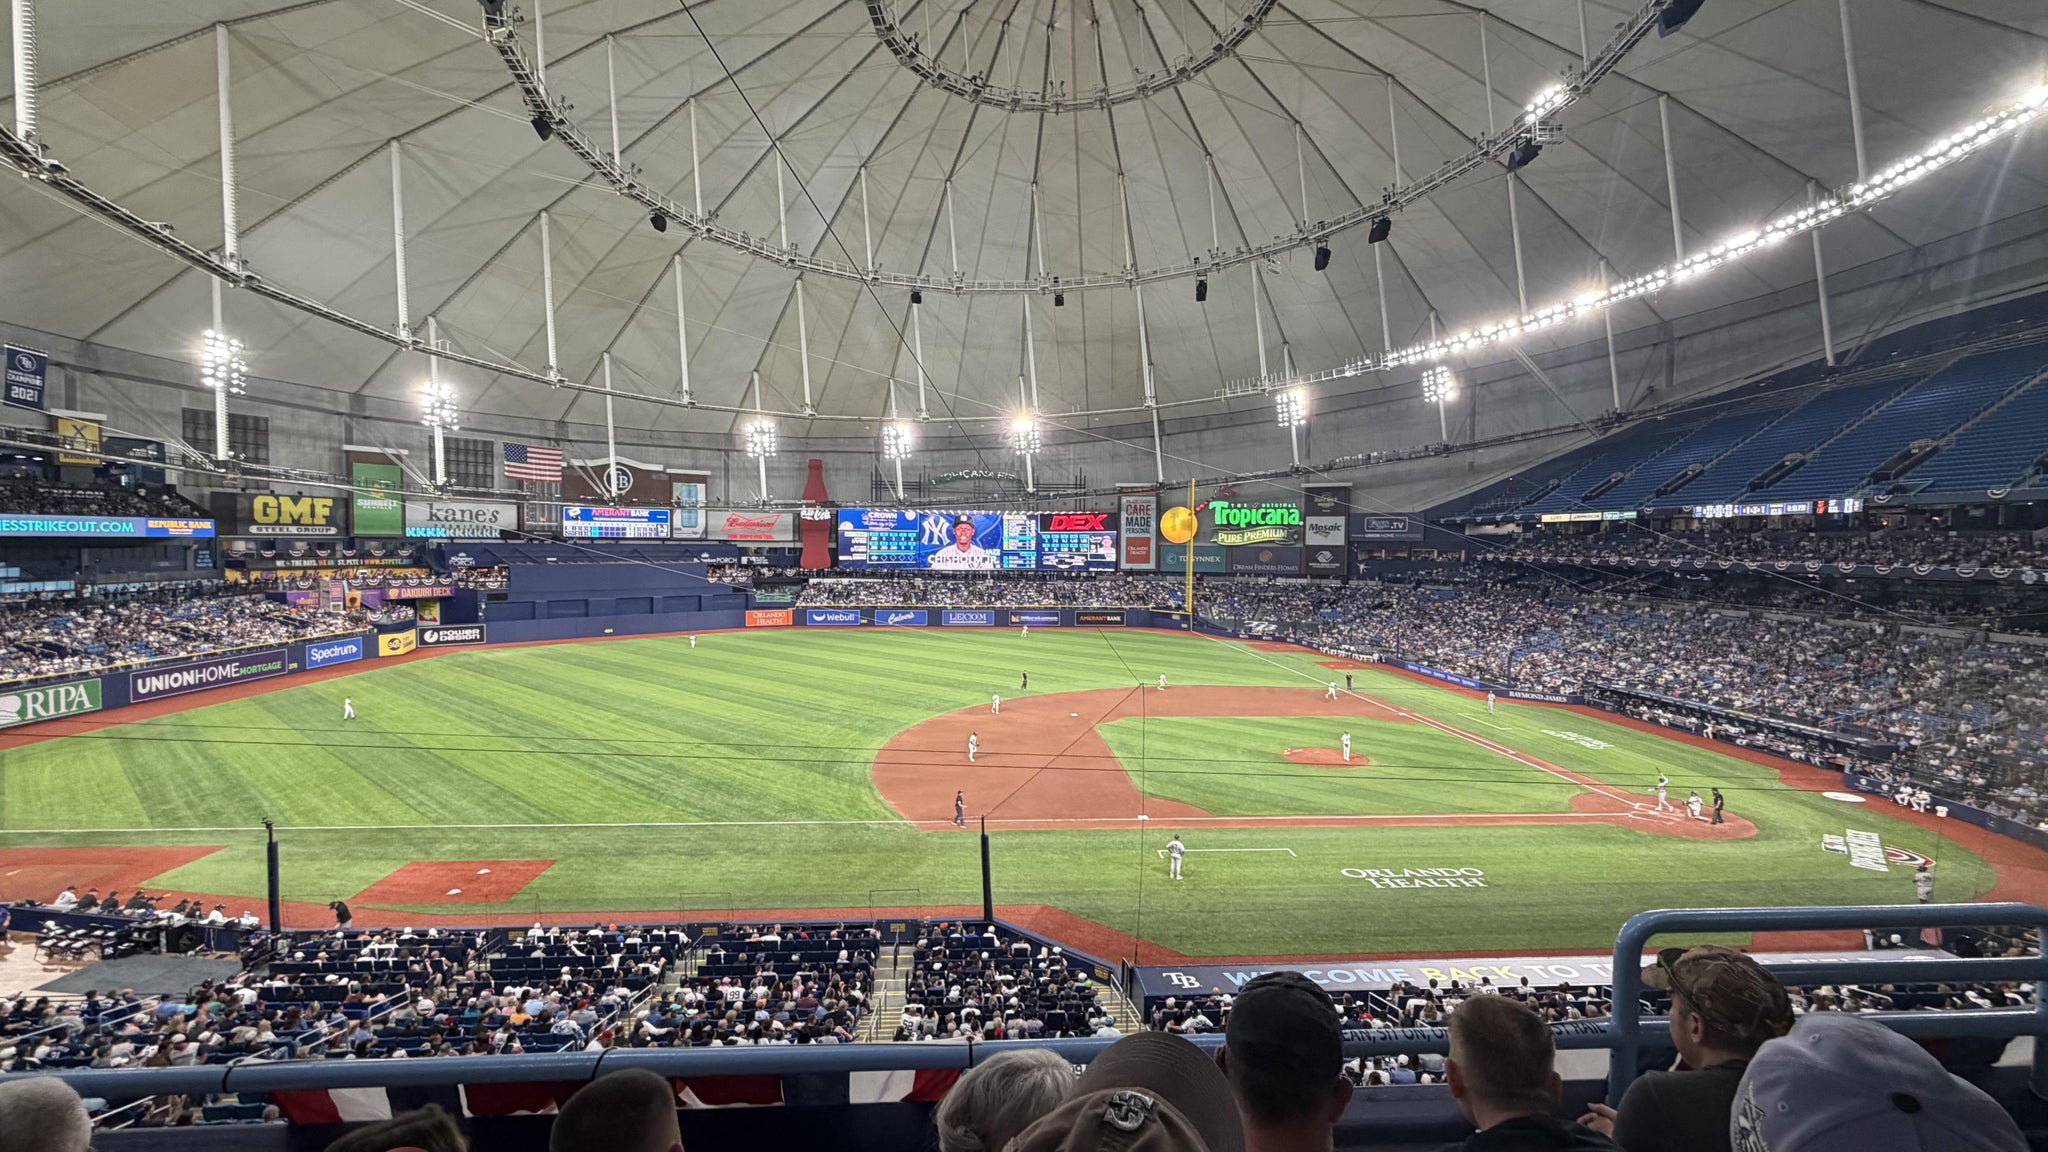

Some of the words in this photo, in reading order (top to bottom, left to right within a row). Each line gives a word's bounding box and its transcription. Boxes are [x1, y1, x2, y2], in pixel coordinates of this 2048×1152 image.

[10, 386, 38, 402] 2021
[253, 495, 334, 525] GMF
[427, 502, 500, 524] kane's
[592, 509, 630, 517] AMERANT
[630, 510, 650, 518] BANK
[867, 511, 898, 519] CROWN
[1125, 504, 1151, 516] CARE
[1208, 500, 1300, 528] Tropicana
[147, 520, 188, 530] REPUBLIC
[188, 521, 212, 530] BANK
[1049, 514, 1108, 531] DEX
[1125, 516, 1151, 528] MADE
[1308, 522, 1342, 533] Mosaic
[1217, 531, 1243, 543] PURE
[1243, 528, 1288, 541] PREMIUM
[716, 556, 738, 564] PORCH
[1233, 563, 1253, 572] DREAM
[1278, 563, 1299, 571] HOMES
[401, 588, 432, 599] DAIQUIRI
[433, 587, 451, 597] DECK
[826, 612, 855, 622] Webull
[949, 612, 987, 621] LECOM
[310, 643, 355, 663] Spectrum
[24, 684, 93, 720] RIPA
[1509, 690, 1545, 702] RAYMOND
[1544, 694, 1568, 703] JAMES
[1340, 867, 1484, 879] ORLANDO
[1365, 877, 1488, 889] HEALTH
[1223, 967, 1415, 988] WCOME
[1418, 965, 1524, 982] BACK
[1522, 964, 1581, 979] TO
[1342, 1029, 1376, 1044] EAN,
